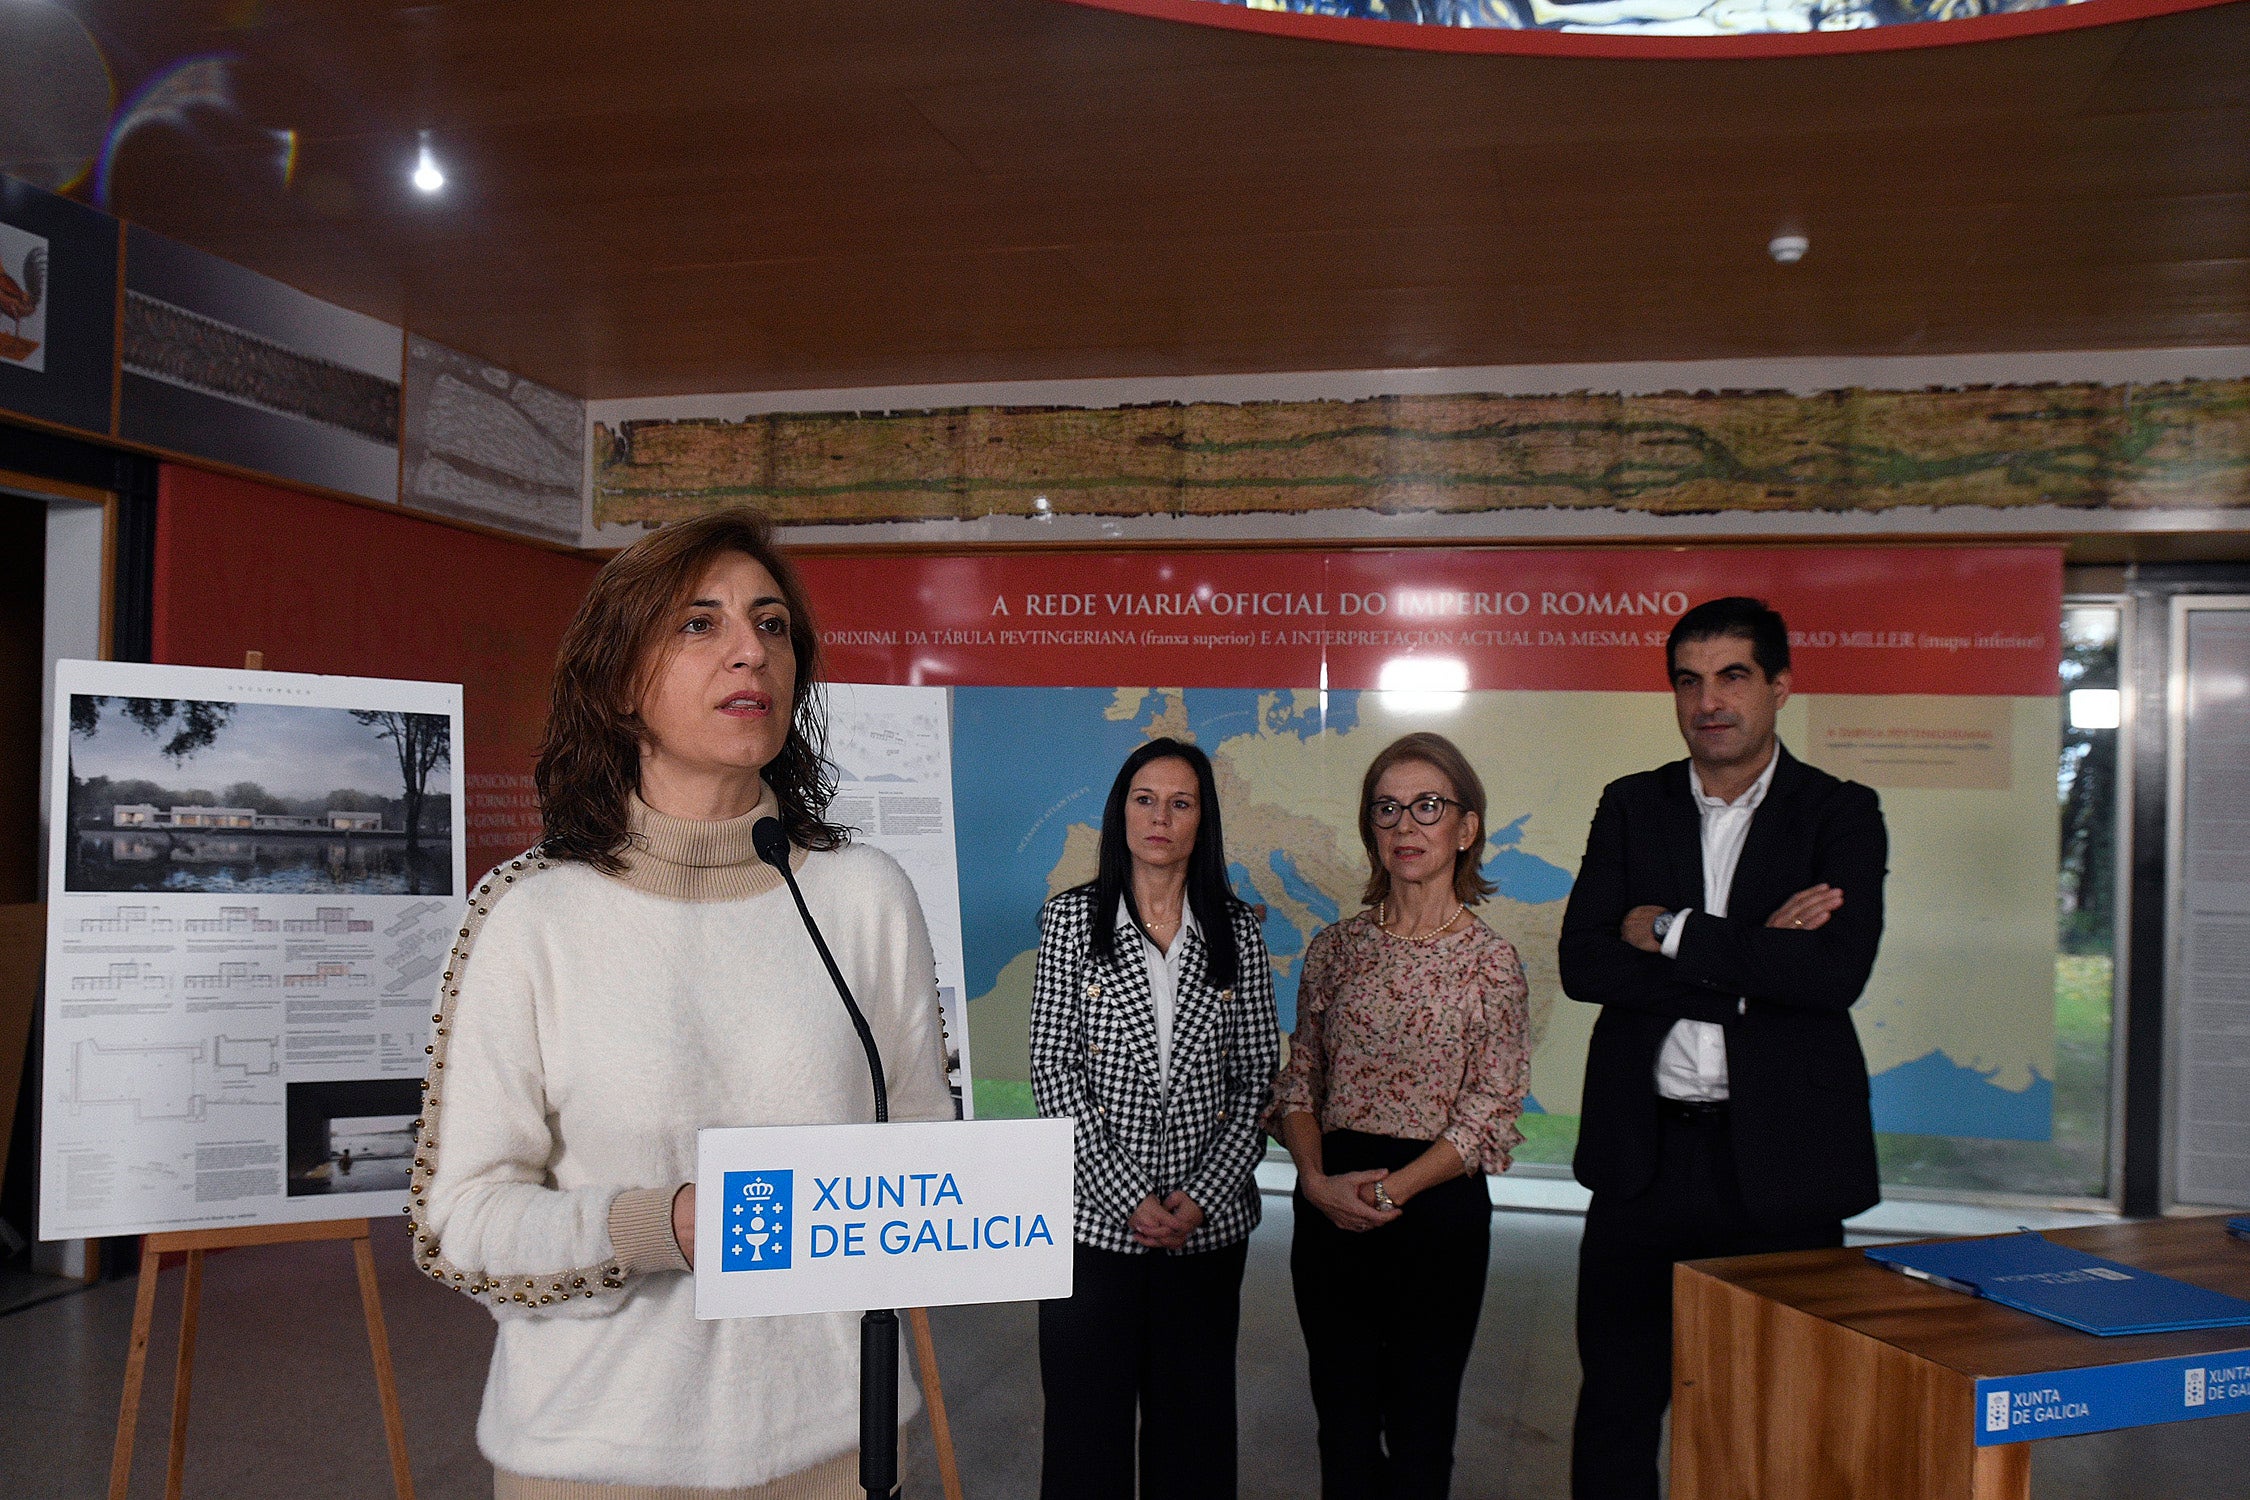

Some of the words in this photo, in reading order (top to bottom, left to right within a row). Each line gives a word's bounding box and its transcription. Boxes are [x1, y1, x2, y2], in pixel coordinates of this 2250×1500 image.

[992, 594, 1009, 616] A
[1026, 594, 1097, 616] REDE
[1104, 594, 1202, 616] VIARIA
[1210, 592, 1330, 616] OFICIAL
[1339, 592, 1387, 616] DO
[1397, 592, 1530, 616] IMPERIO
[1541, 591, 1689, 616] ROMANO
[824, 630, 899, 645] ORIXINAL
[905, 630, 928, 645] DA
[931, 628, 995, 645] TÁBULA
[1000, 630, 1136, 645] PEVTINGERIANA
[1193, 629, 1255, 649] superior)
[1261, 630, 1271, 645] E
[1275, 630, 1287, 645] A
[1459, 630, 1533, 646] ACTUAL
[1539, 630, 1566, 646] DA
[1569, 630, 1640, 646] MESMA
[1643, 630, 1671, 646] SE
[812, 1173, 964, 1212] XUNTA
[810, 1222, 866, 1259] DE
[879, 1214, 1054, 1256] GALICIA
[2013, 1389, 2061, 1408] XUNTA
[2208, 1385, 2225, 1400] DE
[2012, 1408, 2031, 1425] DE
[2034, 1402, 2090, 1422] GALICIA
